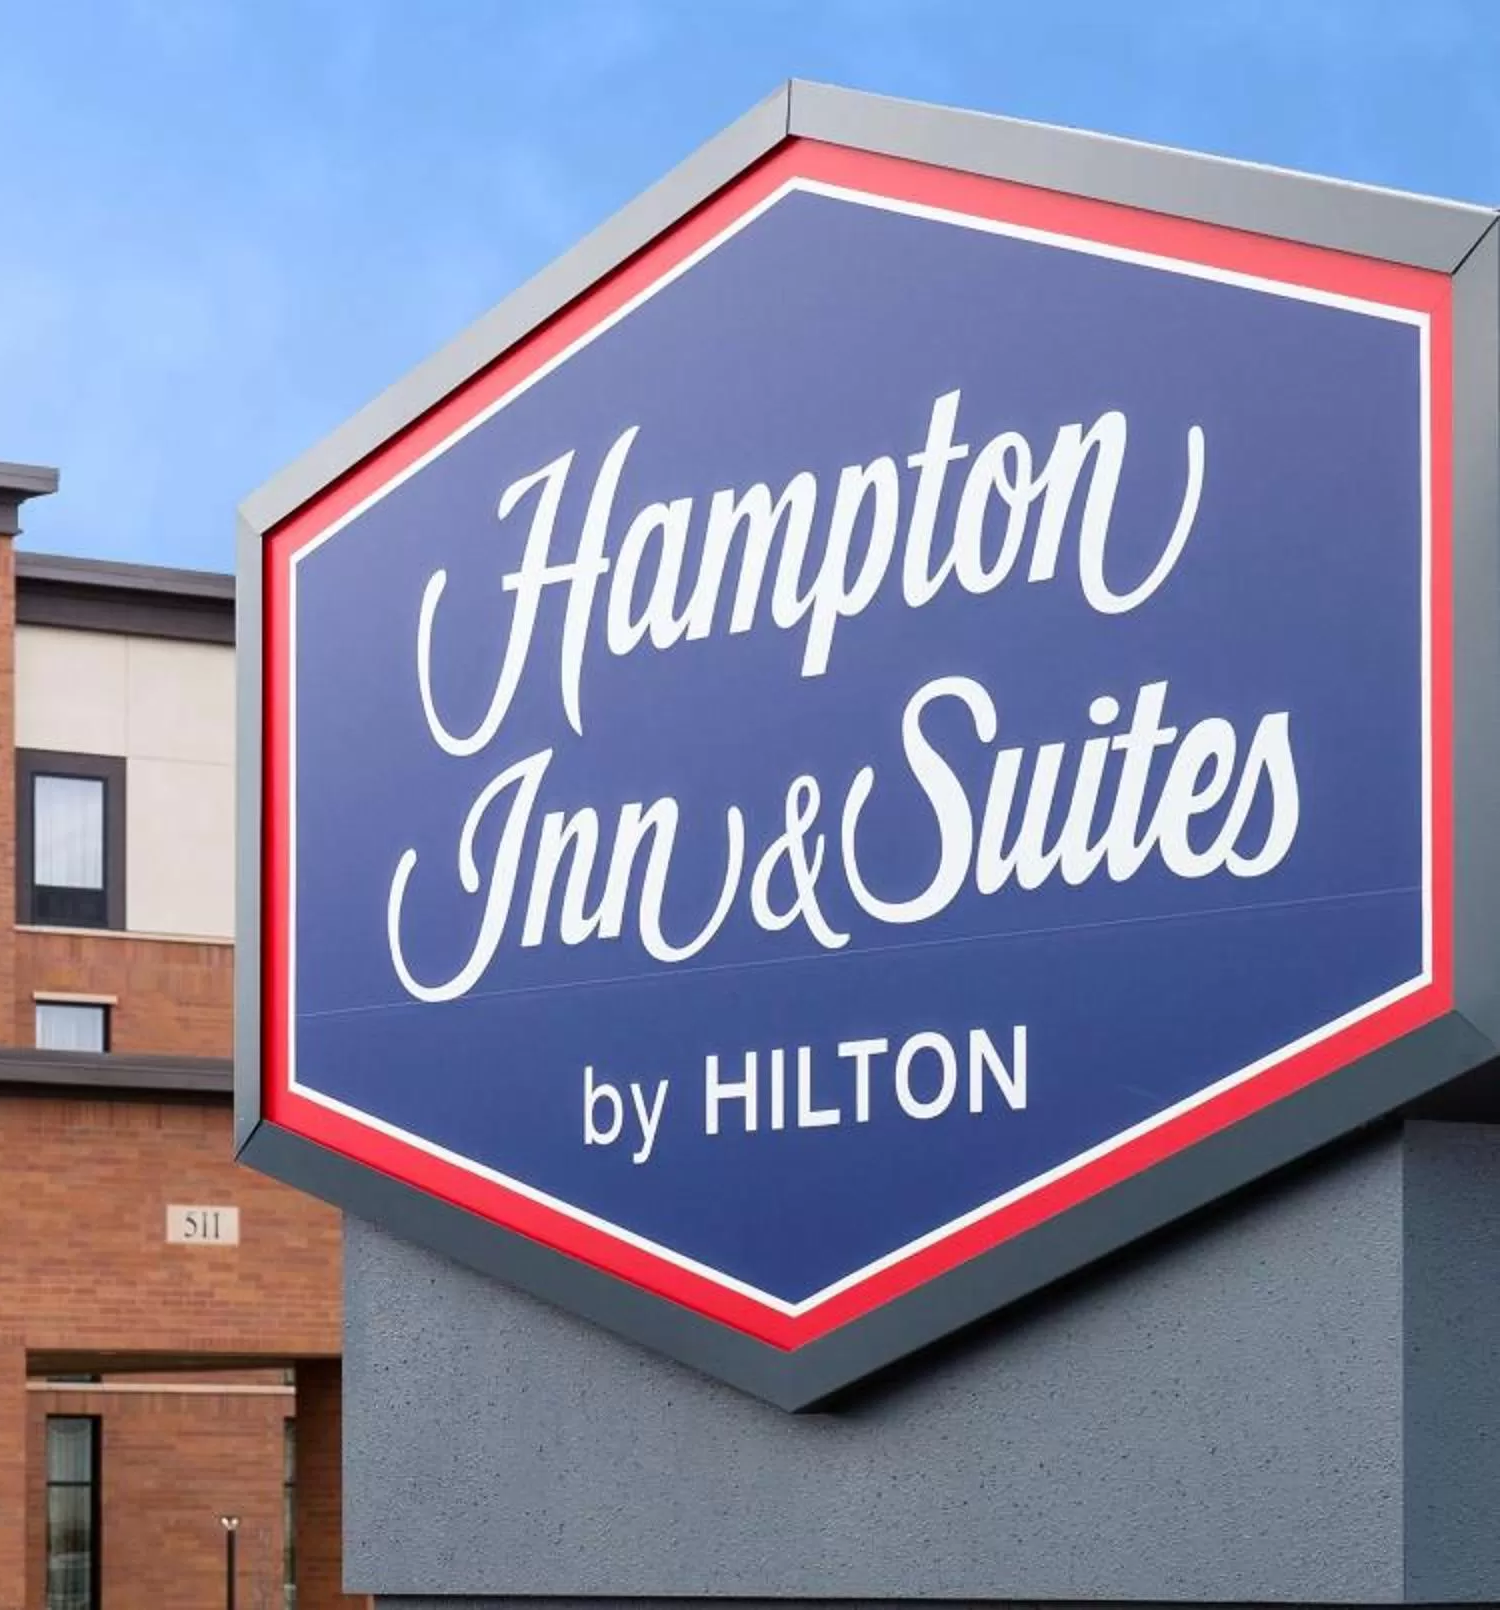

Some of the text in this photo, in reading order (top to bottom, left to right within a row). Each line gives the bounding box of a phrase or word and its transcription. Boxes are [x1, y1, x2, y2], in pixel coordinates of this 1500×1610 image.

[417, 388, 1206, 757] Hampton
[387, 676, 1300, 1003] Inn & Suites
[583, 1024, 1027, 1164] by HILTON
[183, 1210, 220, 1239] 511
